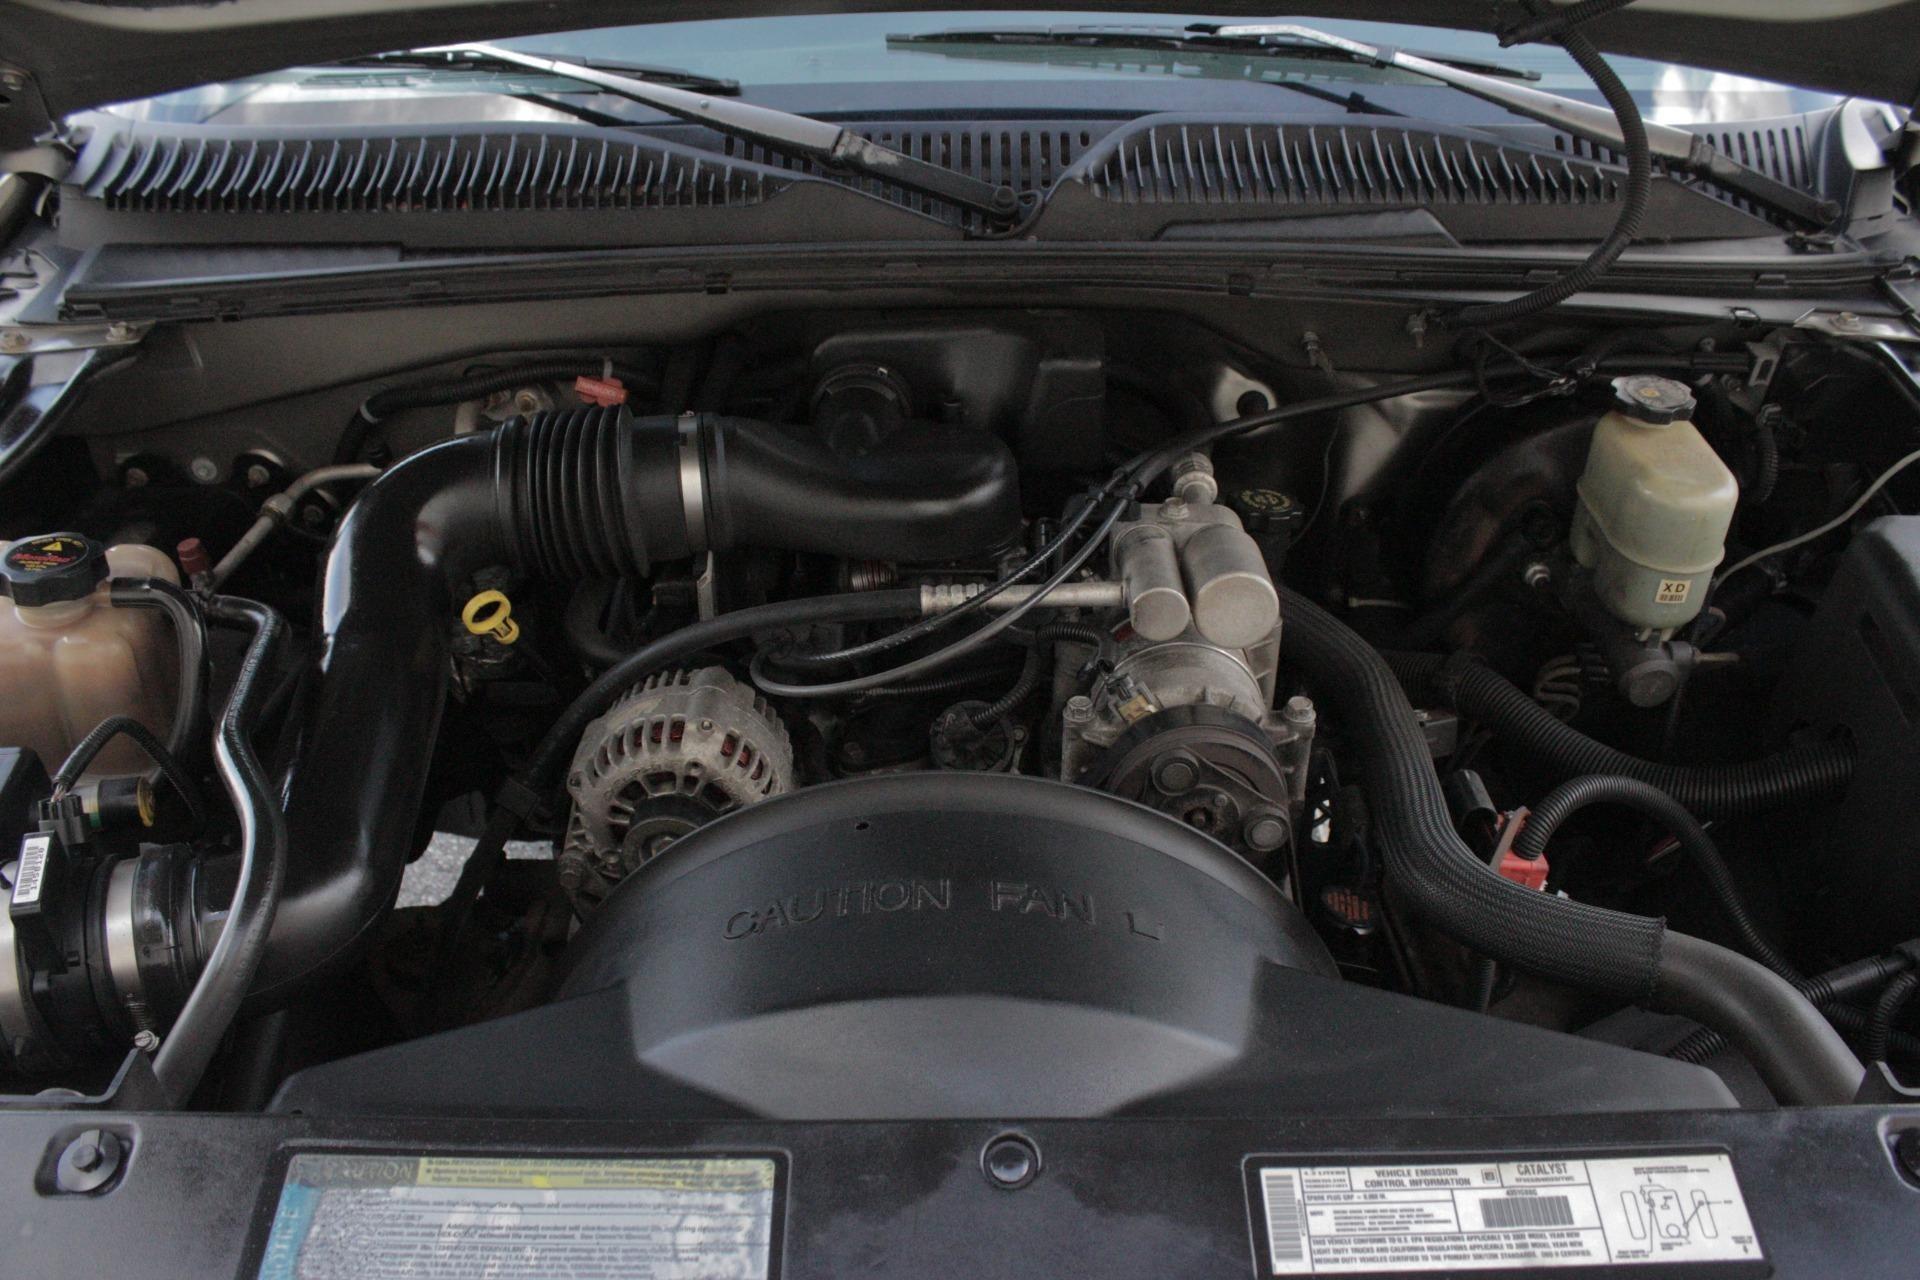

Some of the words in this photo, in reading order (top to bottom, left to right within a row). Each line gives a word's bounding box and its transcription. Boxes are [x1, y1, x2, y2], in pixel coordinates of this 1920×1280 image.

[723, 878, 950, 940] CAUTION
[991, 880, 1097, 926] FAN
[1375, 1169, 1411, 1178] VEHICLE
[1415, 1168, 1458, 1177] EMISSION
[1517, 1163, 1568, 1175] CATALYST
[1364, 1179, 1405, 1188] CONTROL
[1409, 1178, 1471, 1187] INFORMATION
[1424, 1235, 1465, 1243] REGULATIONS
[1467, 1234, 1501, 1242] APPLICABLE
[1469, 1243, 1504, 1251] APPLICABLE
